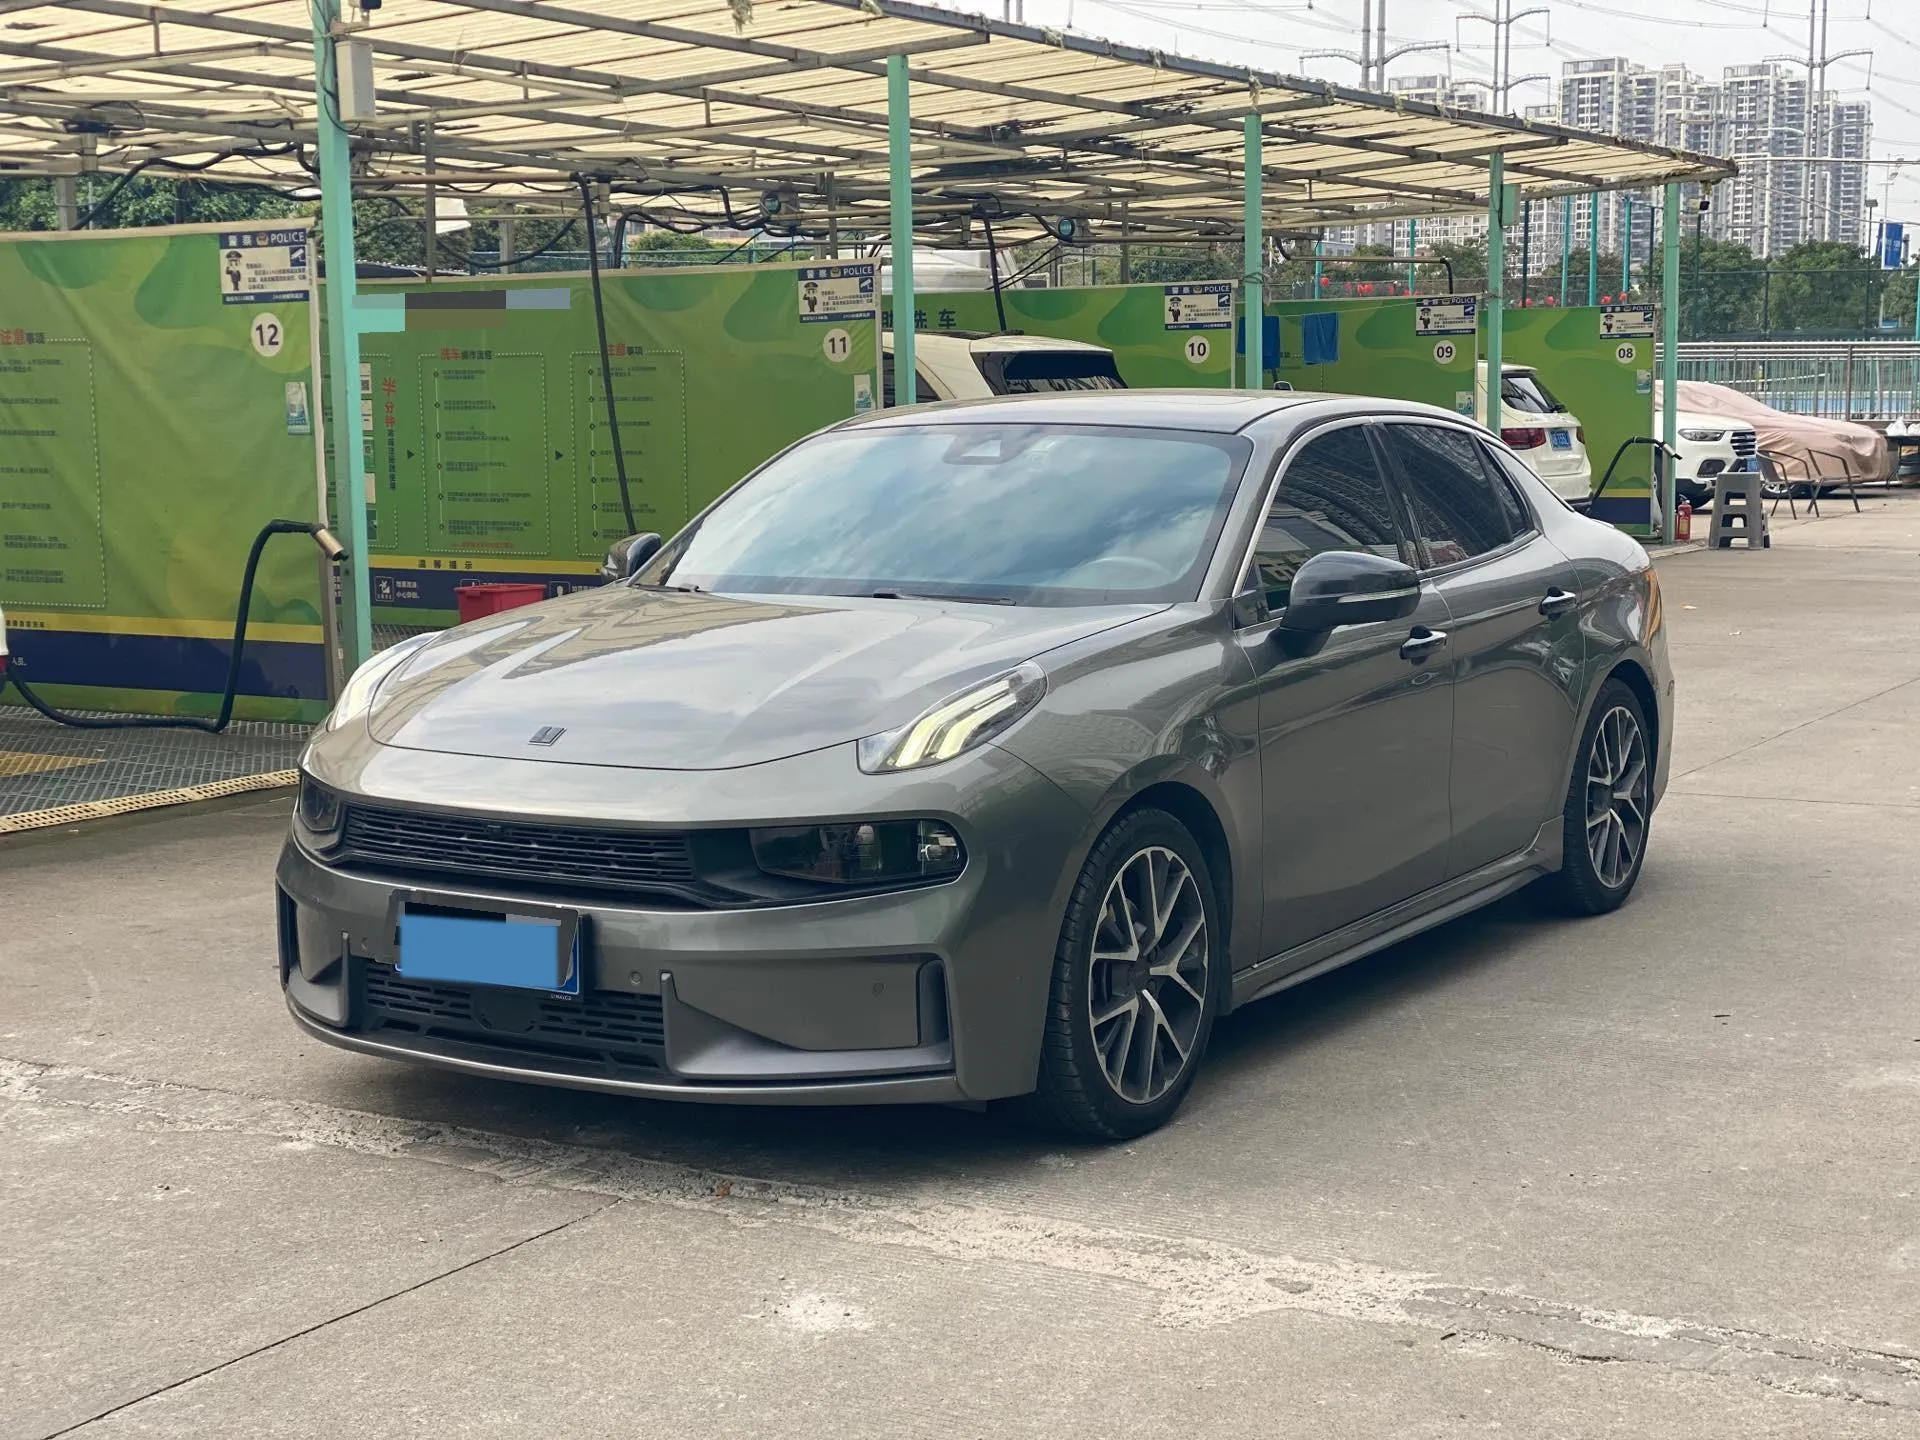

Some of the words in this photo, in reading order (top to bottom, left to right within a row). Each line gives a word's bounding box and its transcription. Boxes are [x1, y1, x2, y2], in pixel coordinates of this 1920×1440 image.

[270, 231, 305, 244] POLICE
[843, 266, 873, 276] POLICE
[1204, 285, 1230, 293] POLICE
[255, 323, 279, 346] 12
[828, 336, 847, 354] 11
[1188, 342, 1207, 357] 10
[1436, 345, 1453, 358] 09
[1618, 347, 1633, 359] 08
